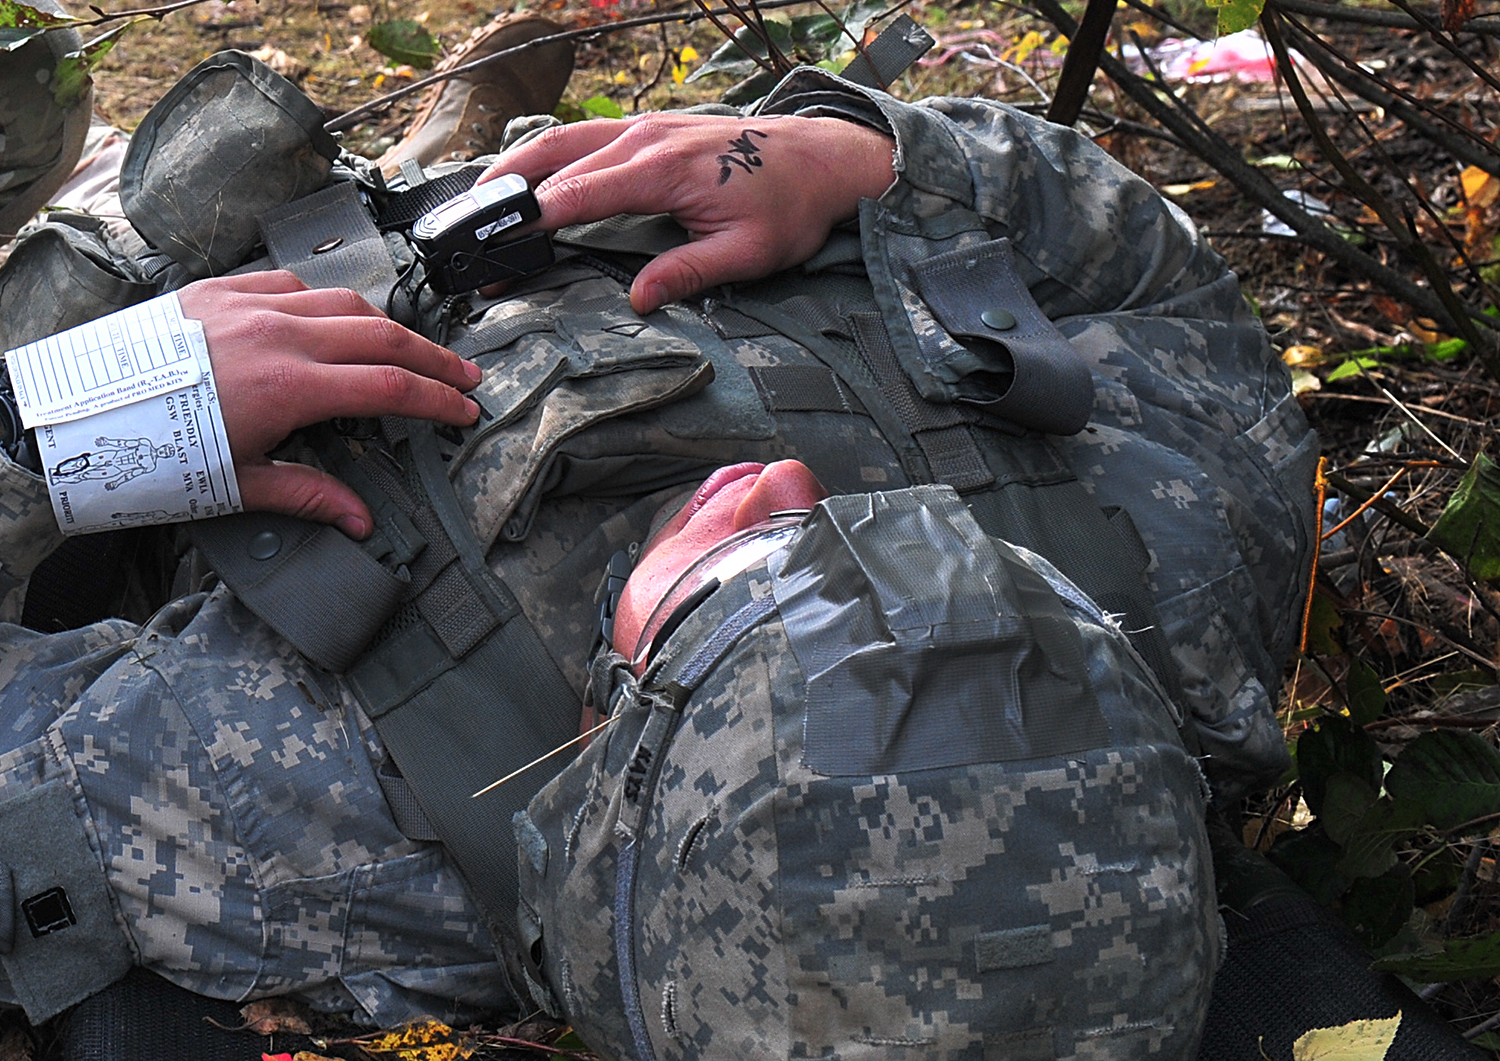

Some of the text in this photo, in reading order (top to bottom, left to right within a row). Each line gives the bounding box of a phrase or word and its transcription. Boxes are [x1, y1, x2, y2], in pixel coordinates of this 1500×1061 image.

[117, 347, 130, 369] TIME
[173, 333, 188, 357] TIME
[36, 401, 72, 418] Treatment
[74, 389, 115, 409] Application
[116, 382, 136, 394] Band
[99, 397, 123, 409] product
[131, 389, 147, 397] PRO
[148, 383, 166, 393] MED
[168, 378, 183, 387] KITS
[165, 396, 178, 421] GSW
[173, 431, 188, 465] BLAST
[182, 473, 193, 492] MVA
[178, 394, 199, 448] FRIENDLY
[196, 470, 207, 494] EWIA
[59, 490, 75, 524] PRIORITY
